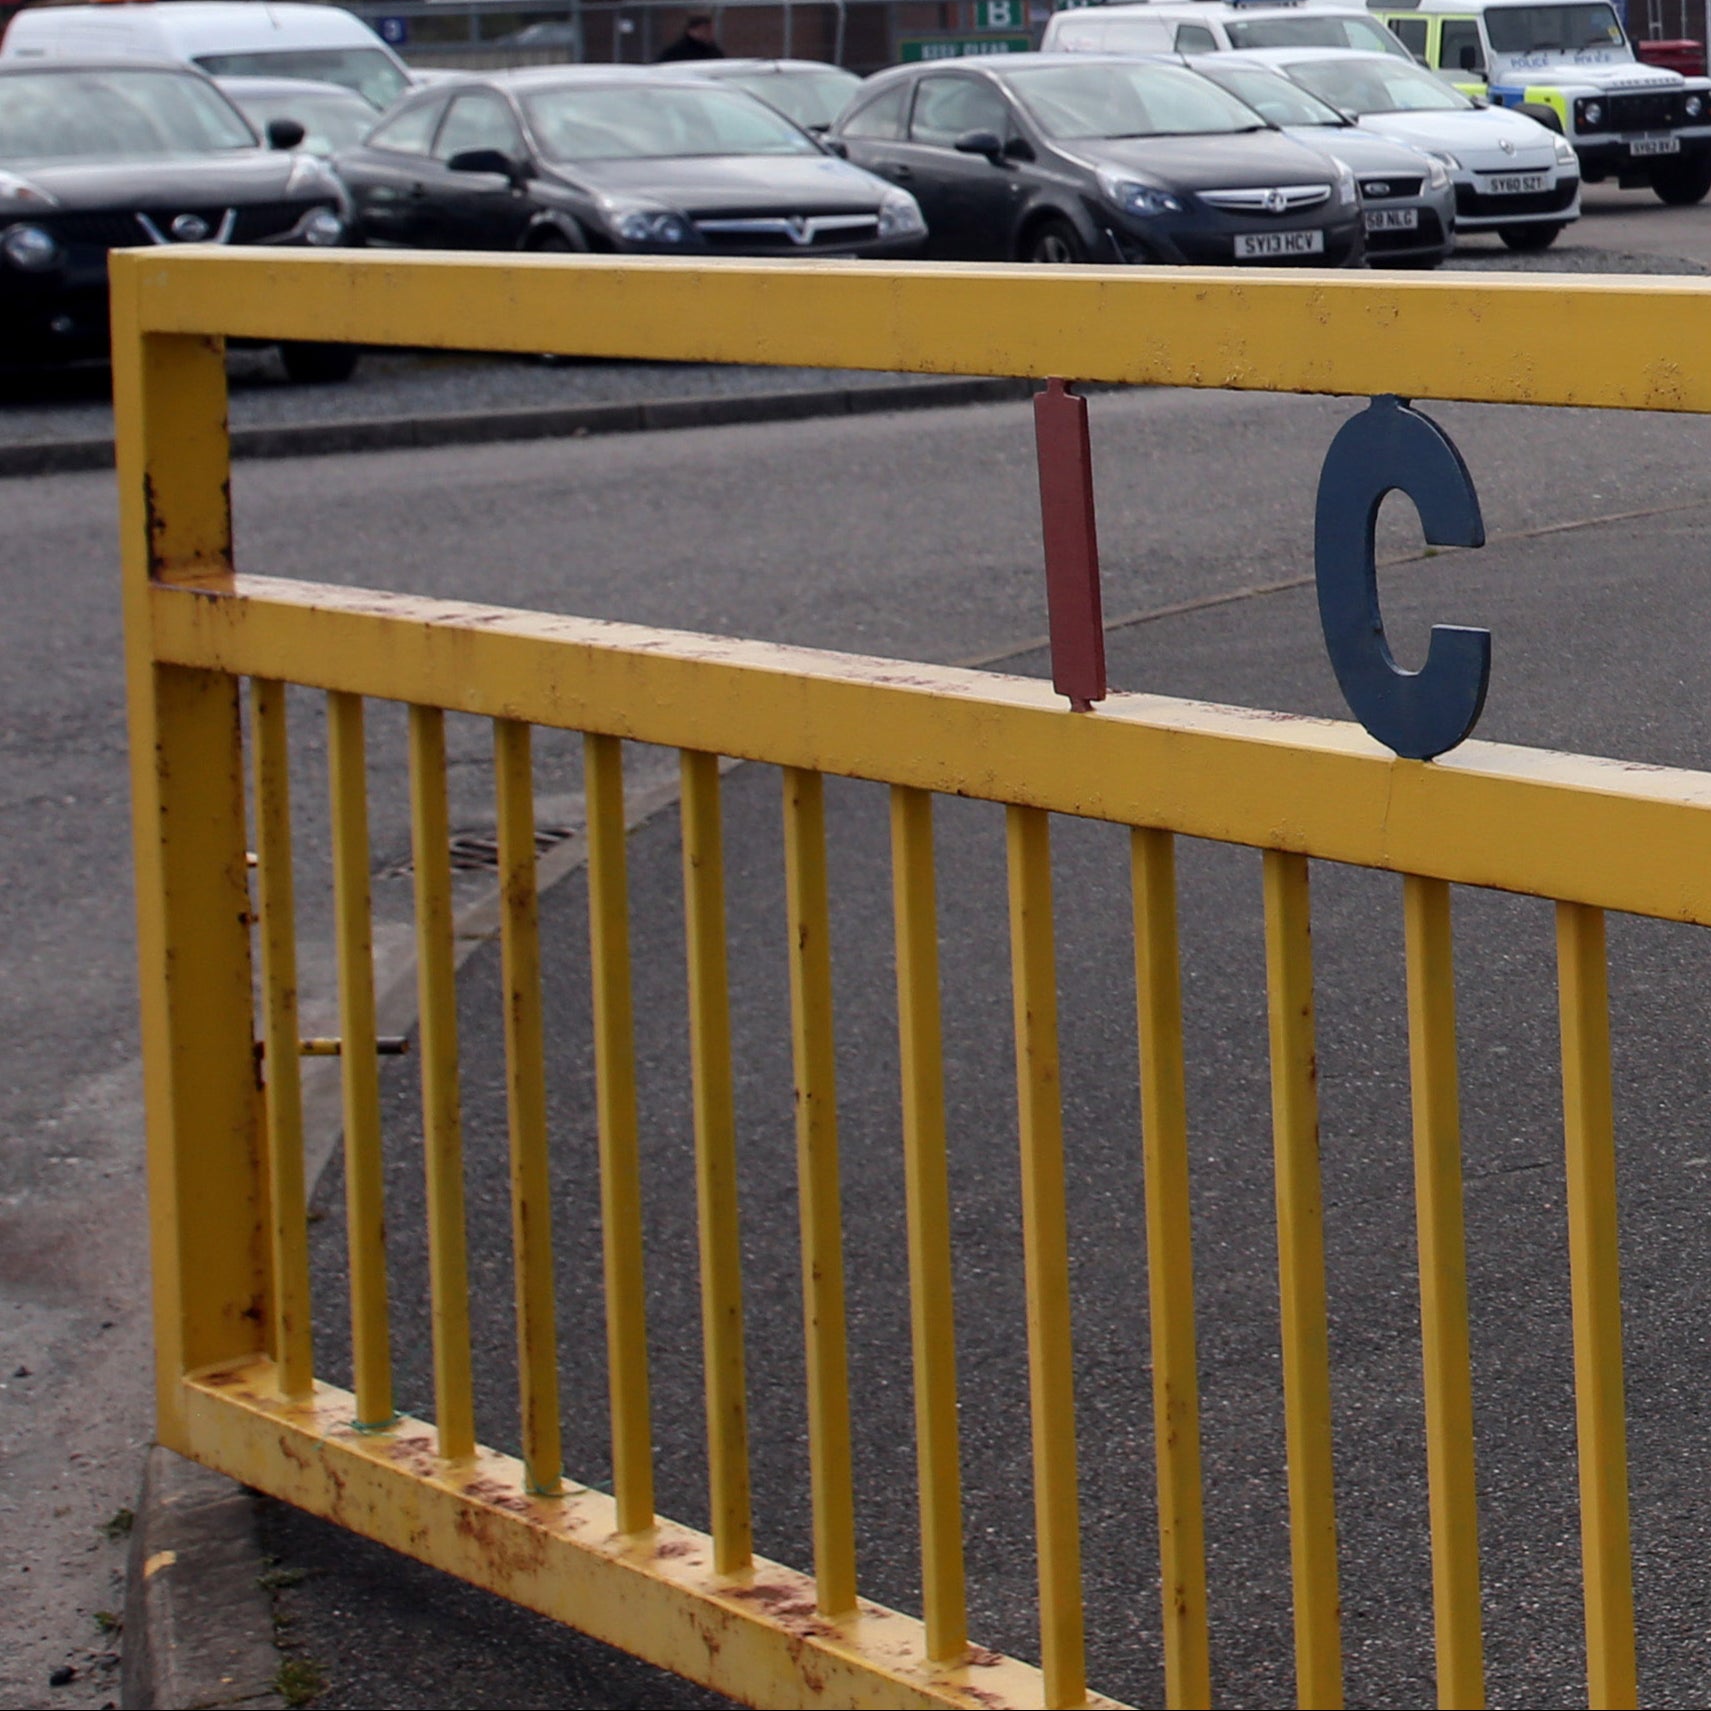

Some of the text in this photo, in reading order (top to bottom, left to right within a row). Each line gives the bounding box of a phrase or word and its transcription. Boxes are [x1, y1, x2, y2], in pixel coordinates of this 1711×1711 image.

[986, 0, 1012, 27] B
[1510, 53, 1612, 68] POLICE POLICE
[1491, 175, 1542, 191] SY60 SZT
[1384, 210, 1413, 228] NLG
[1245, 234, 1314, 254] SY13 HCV
